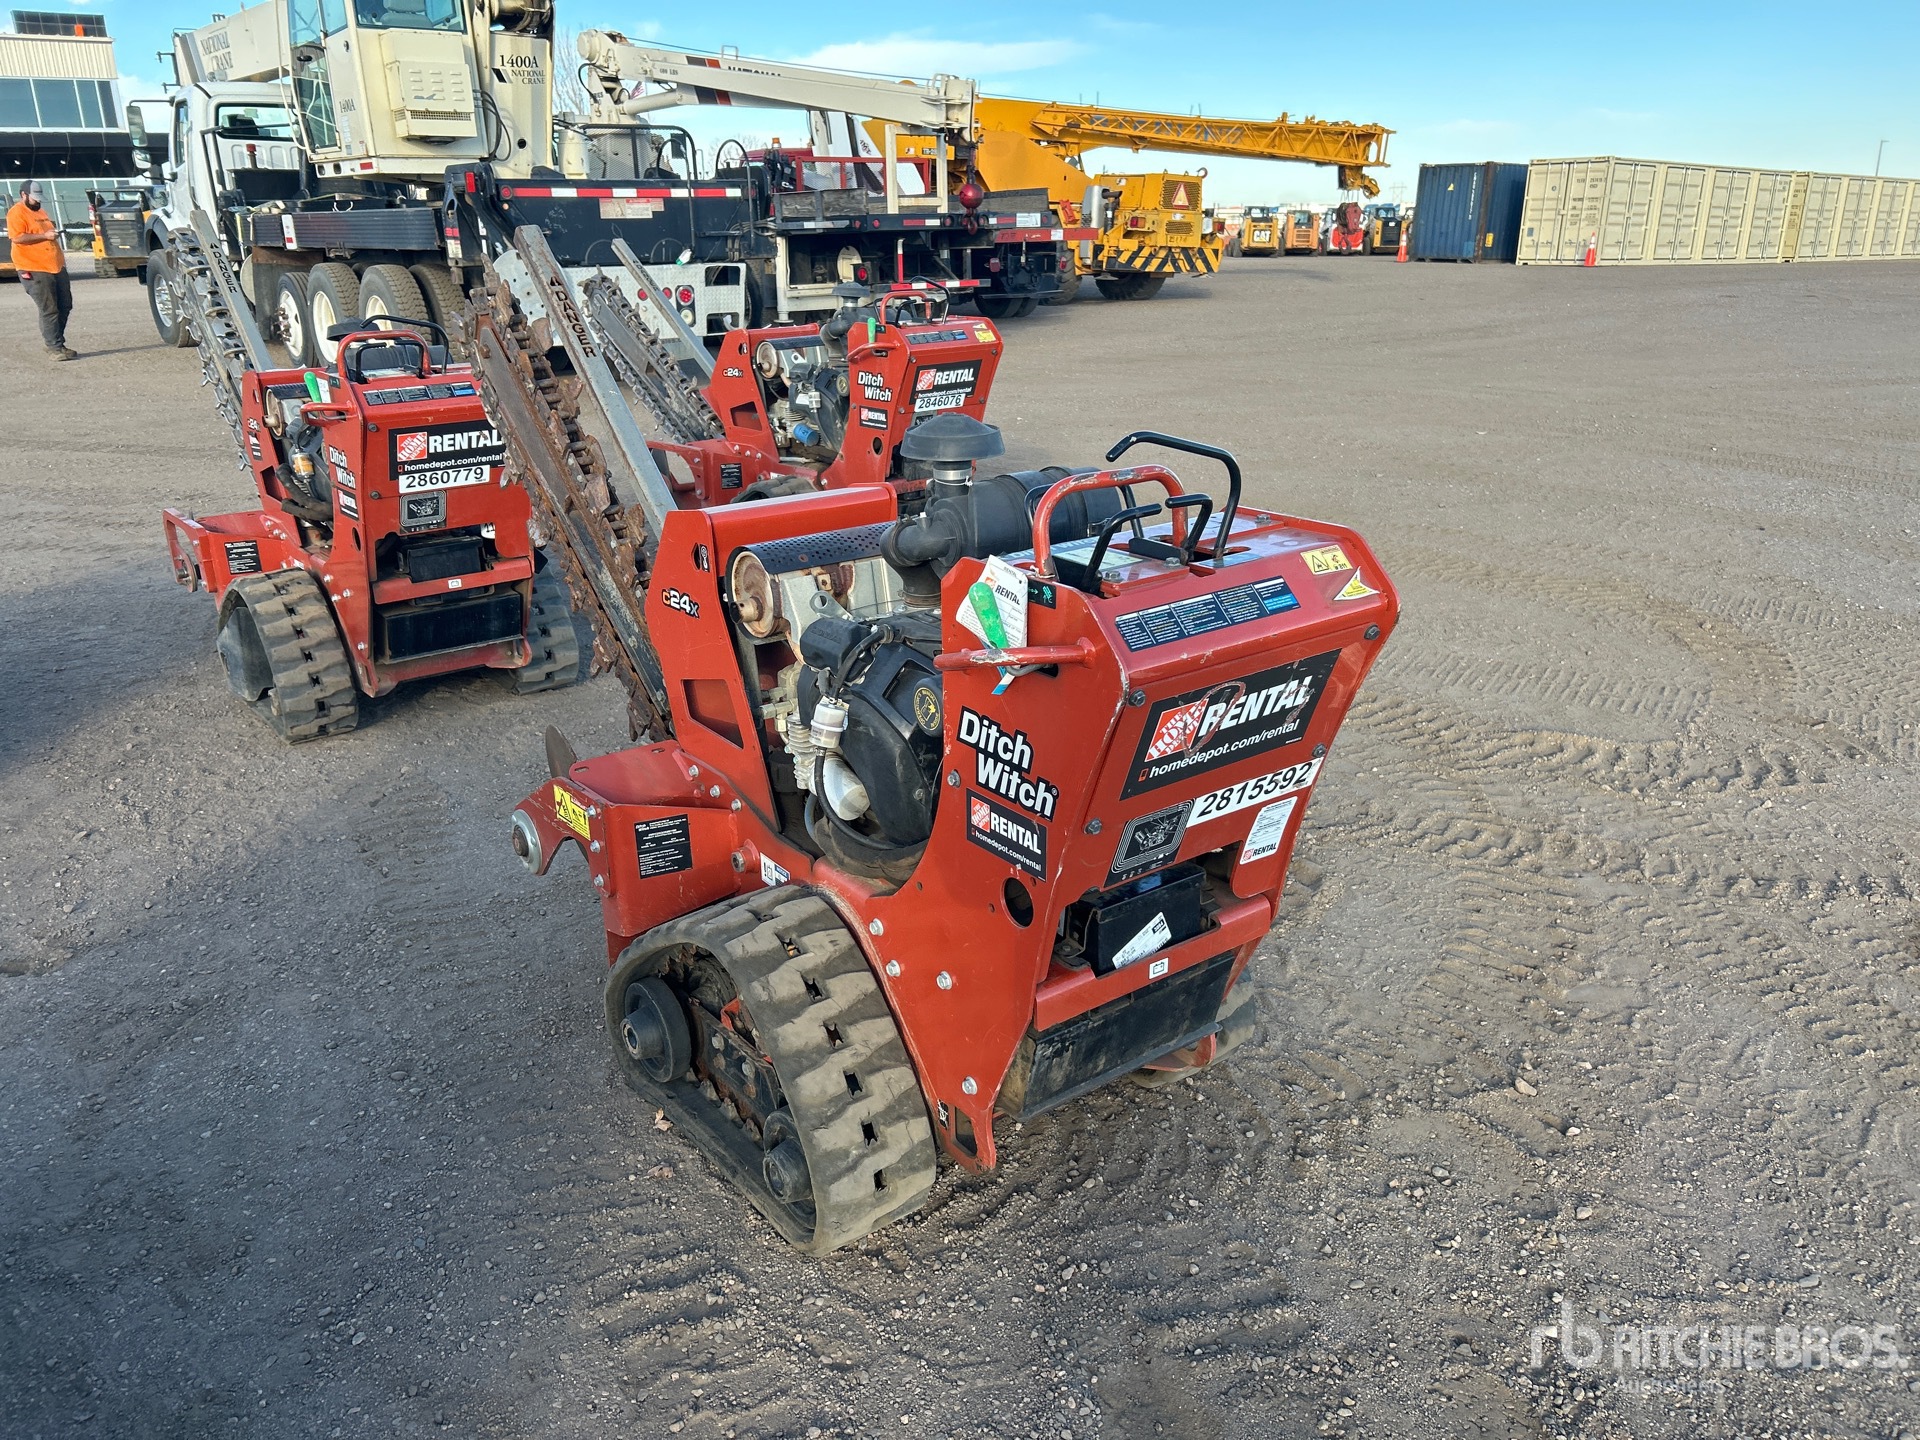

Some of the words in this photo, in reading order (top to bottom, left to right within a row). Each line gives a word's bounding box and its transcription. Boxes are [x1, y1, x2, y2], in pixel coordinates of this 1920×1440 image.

[499, 54, 539, 68] 1400A
[511, 69, 545, 77] NATIONAL
[521, 77, 545, 85] CRANE
[1253, 230, 1272, 243] CAT
[213, 251, 238, 293] DANGER
[555, 290, 597, 357] DANGER
[858, 371, 884, 387] Ditch
[933, 368, 975, 385] RENTAL
[864, 386, 892, 402] Witch
[918, 394, 962, 409] 2846076
[397, 432, 427, 460] HOME
[428, 429, 503, 454] RENTAL
[329, 446, 348, 468] Ditch
[404, 453, 503, 472] homedepot.com/rental
[336, 469, 357, 488] Witch
[405, 466, 484, 489] 2860779
[995, 585, 1020, 606] RENTAL
[1197, 675, 1313, 738] RENTAL
[1147, 703, 1206, 760] HOME
[1159, 711, 1183, 735] THE
[958, 709, 1032, 771] Ditch
[1148, 718, 1301, 779] homedepot.com/rental
[1196, 760, 1314, 819] 2815592
[972, 804, 990, 826] HOME
[990, 811, 1042, 856] RENTAL
[975, 830, 1042, 873] homedepot.com/rental
[1252, 842, 1278, 857] RENTAL
